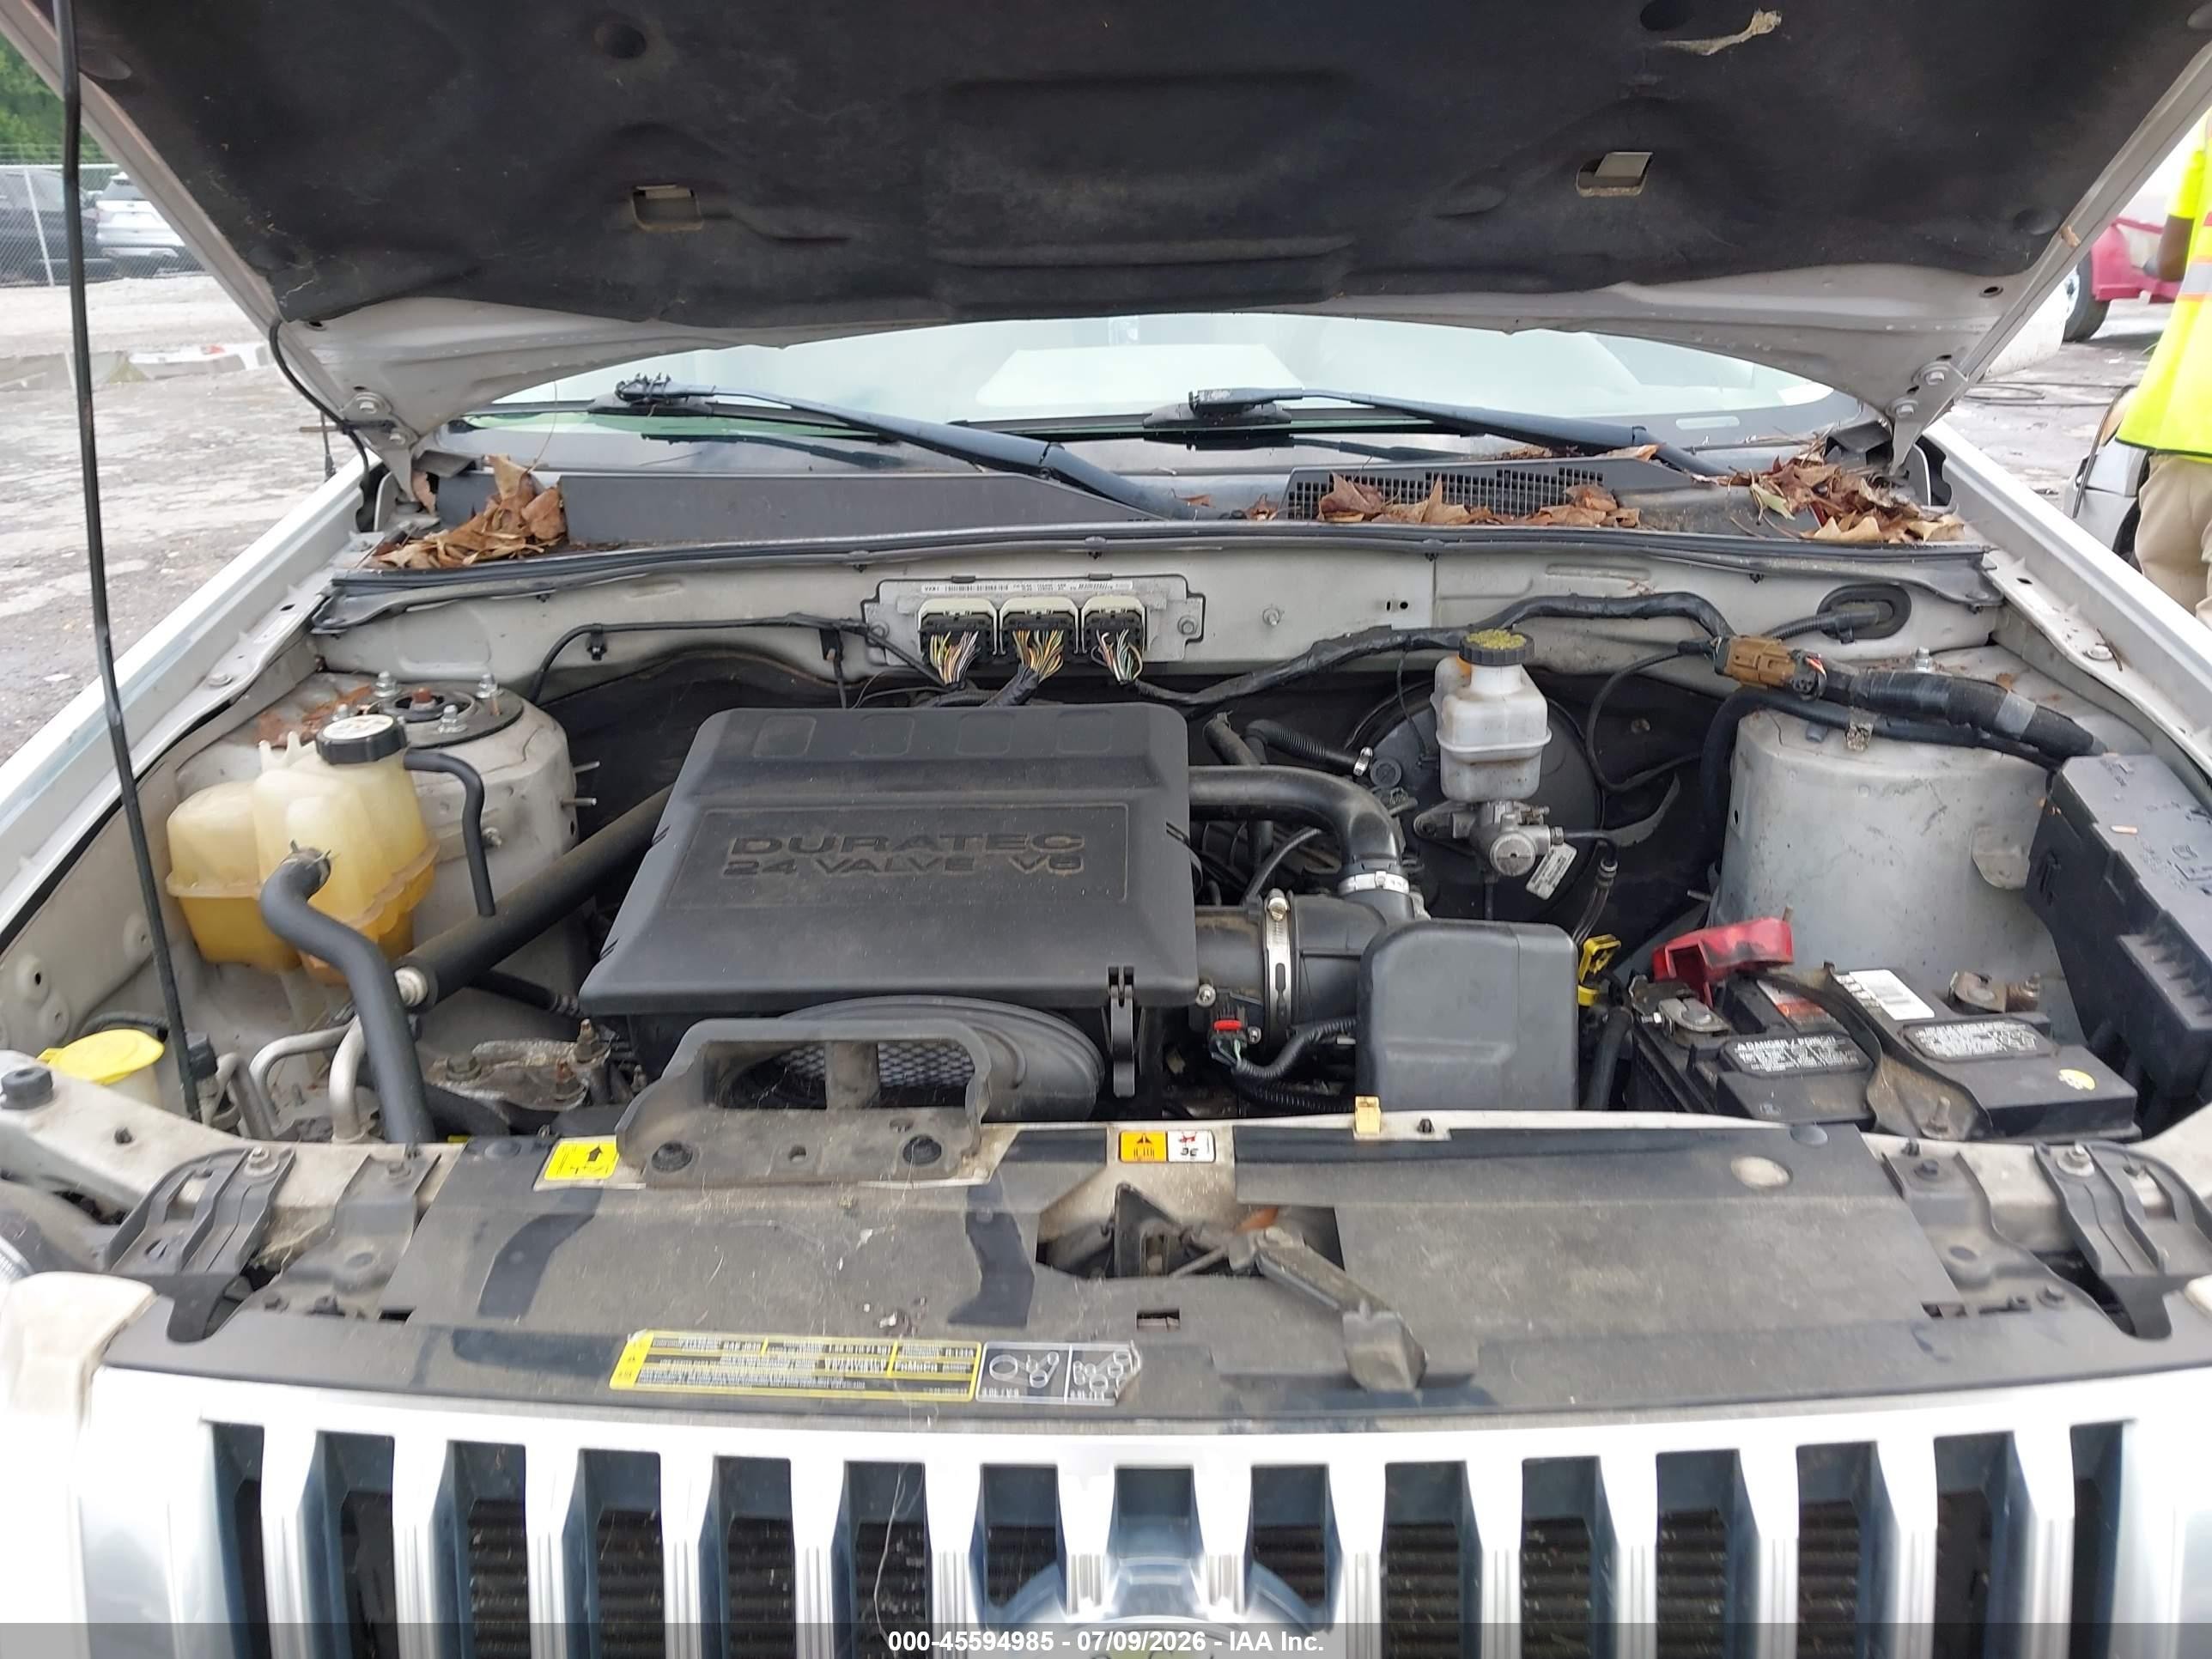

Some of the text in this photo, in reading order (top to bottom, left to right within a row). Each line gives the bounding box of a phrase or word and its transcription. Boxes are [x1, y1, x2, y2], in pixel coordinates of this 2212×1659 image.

[729, 833, 1086, 855] DURATEC
[722, 854, 1085, 877] 24 VALVE V6
